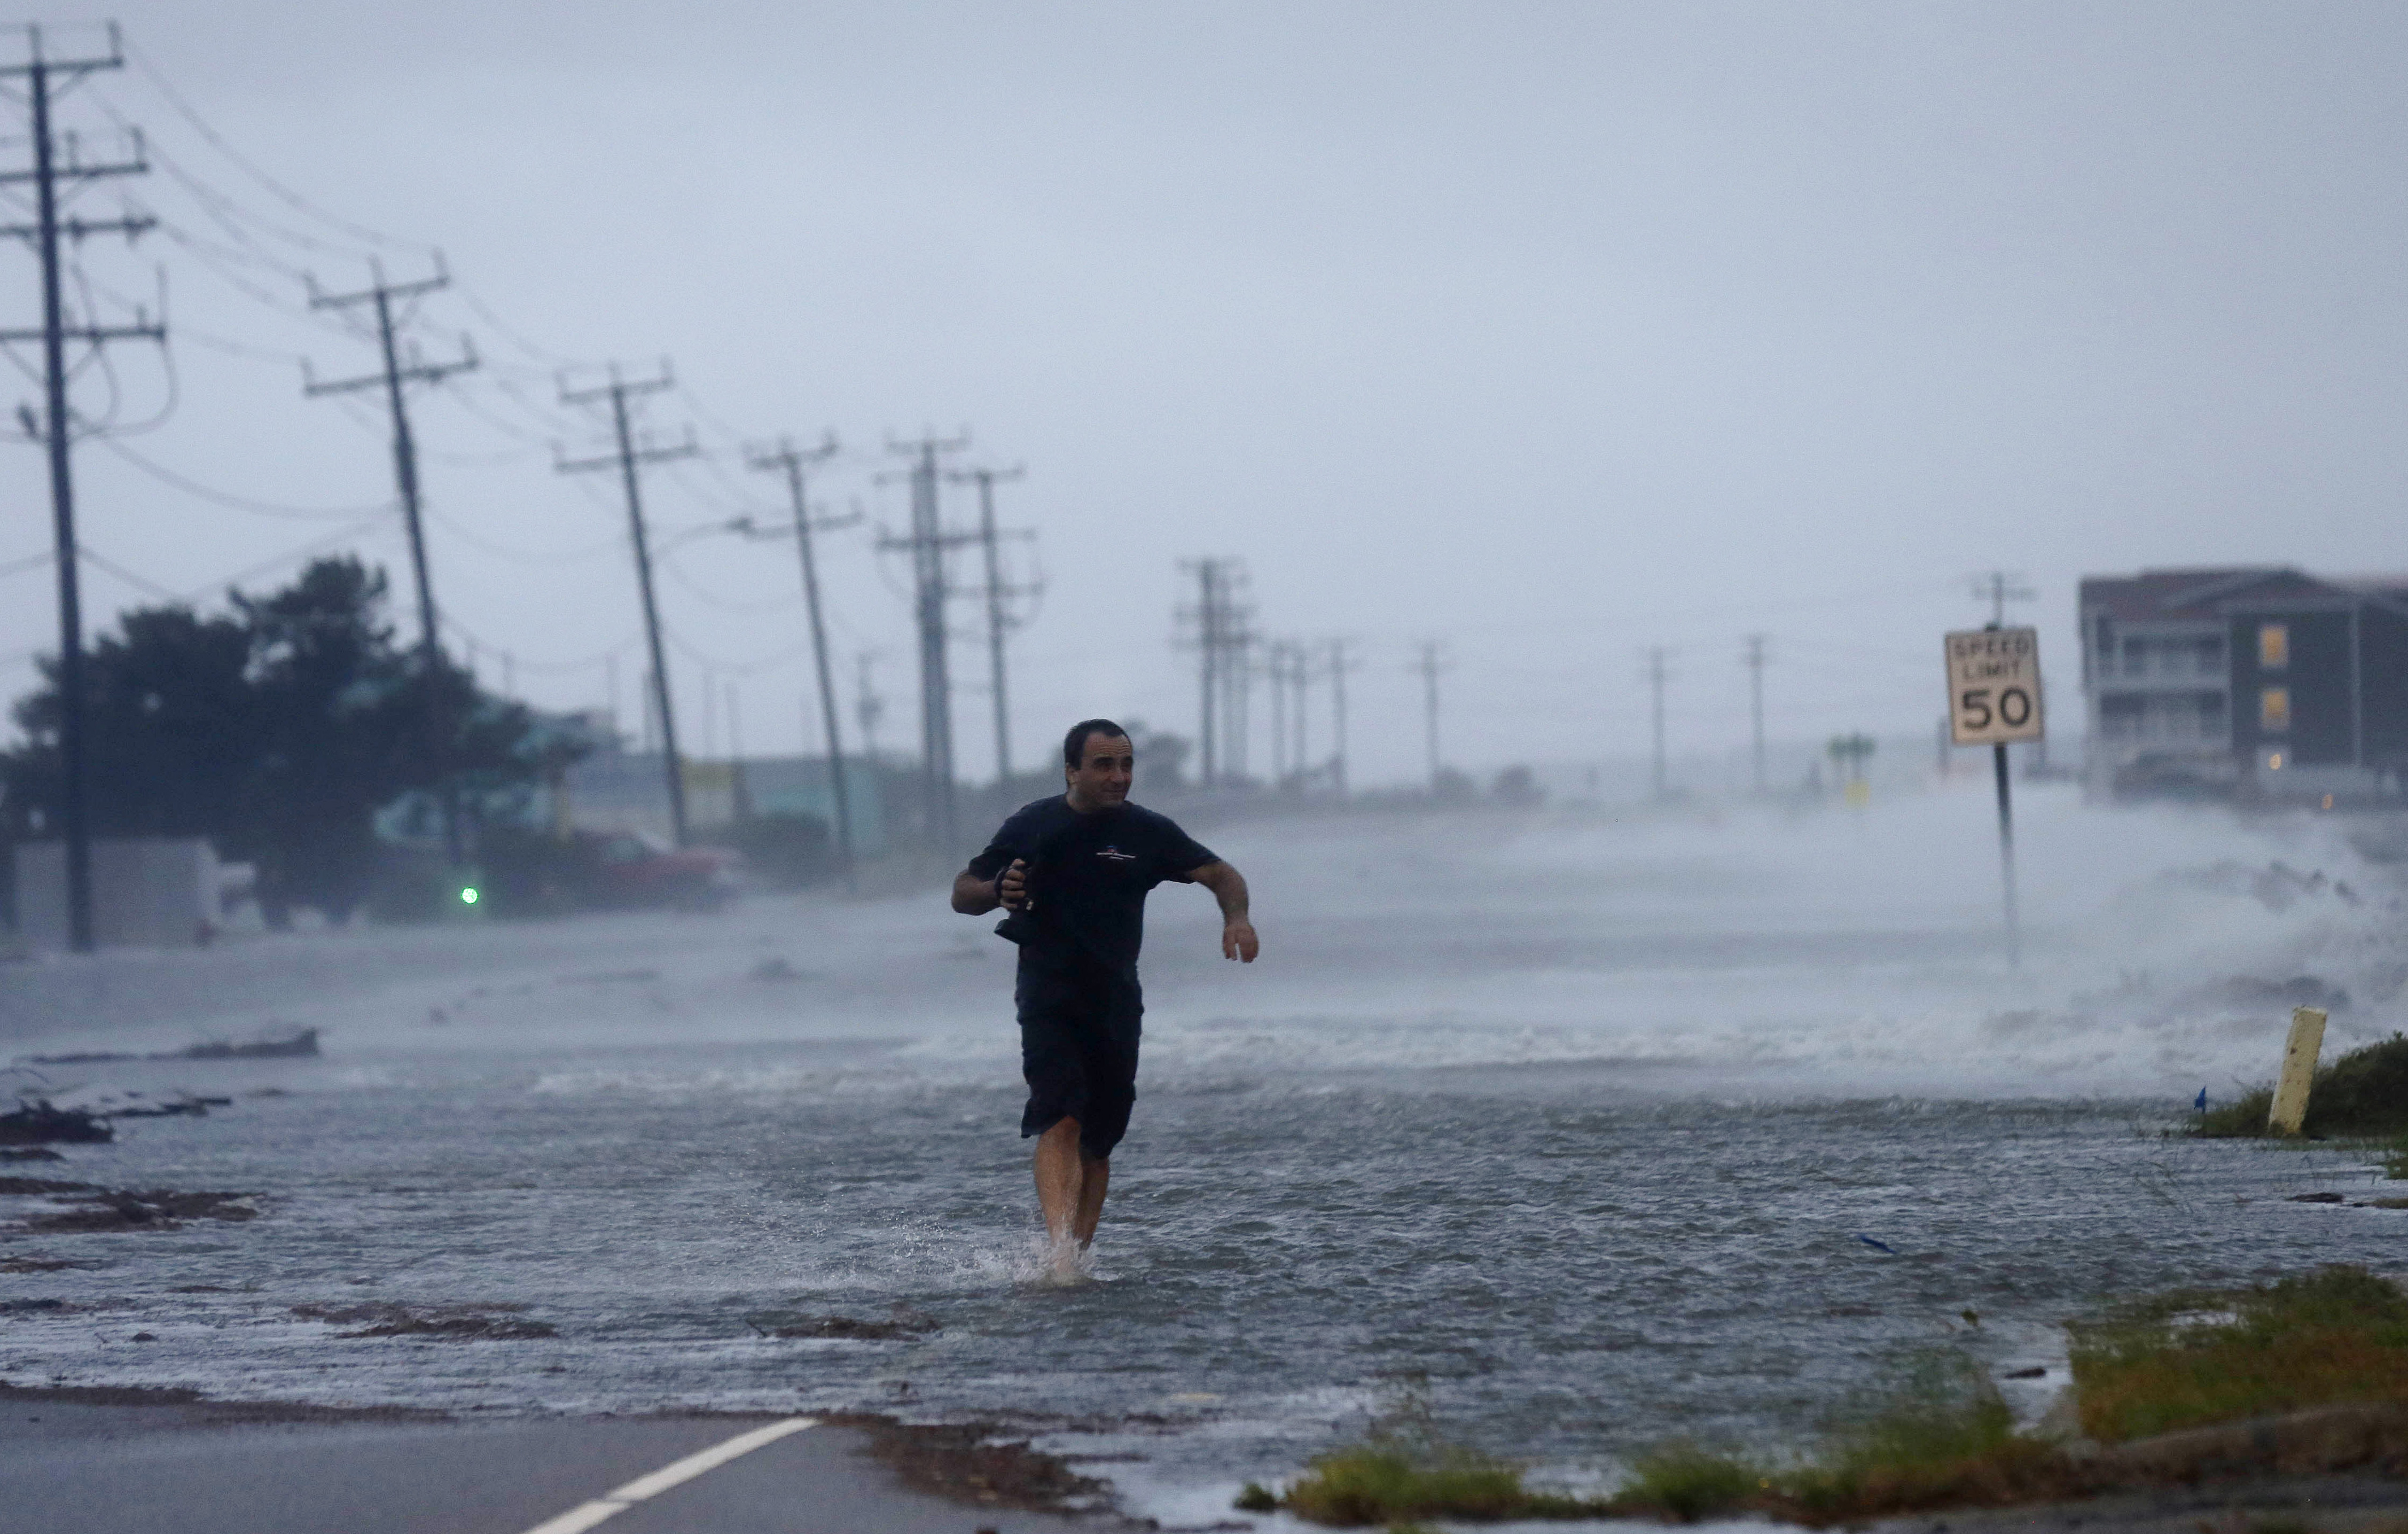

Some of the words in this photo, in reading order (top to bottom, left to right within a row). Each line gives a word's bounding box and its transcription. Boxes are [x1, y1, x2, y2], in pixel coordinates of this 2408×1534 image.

[1954, 637, 2030, 659] SPEED
[1962, 660, 2020, 681] LIMIT
[1962, 686, 2031, 730] 50
